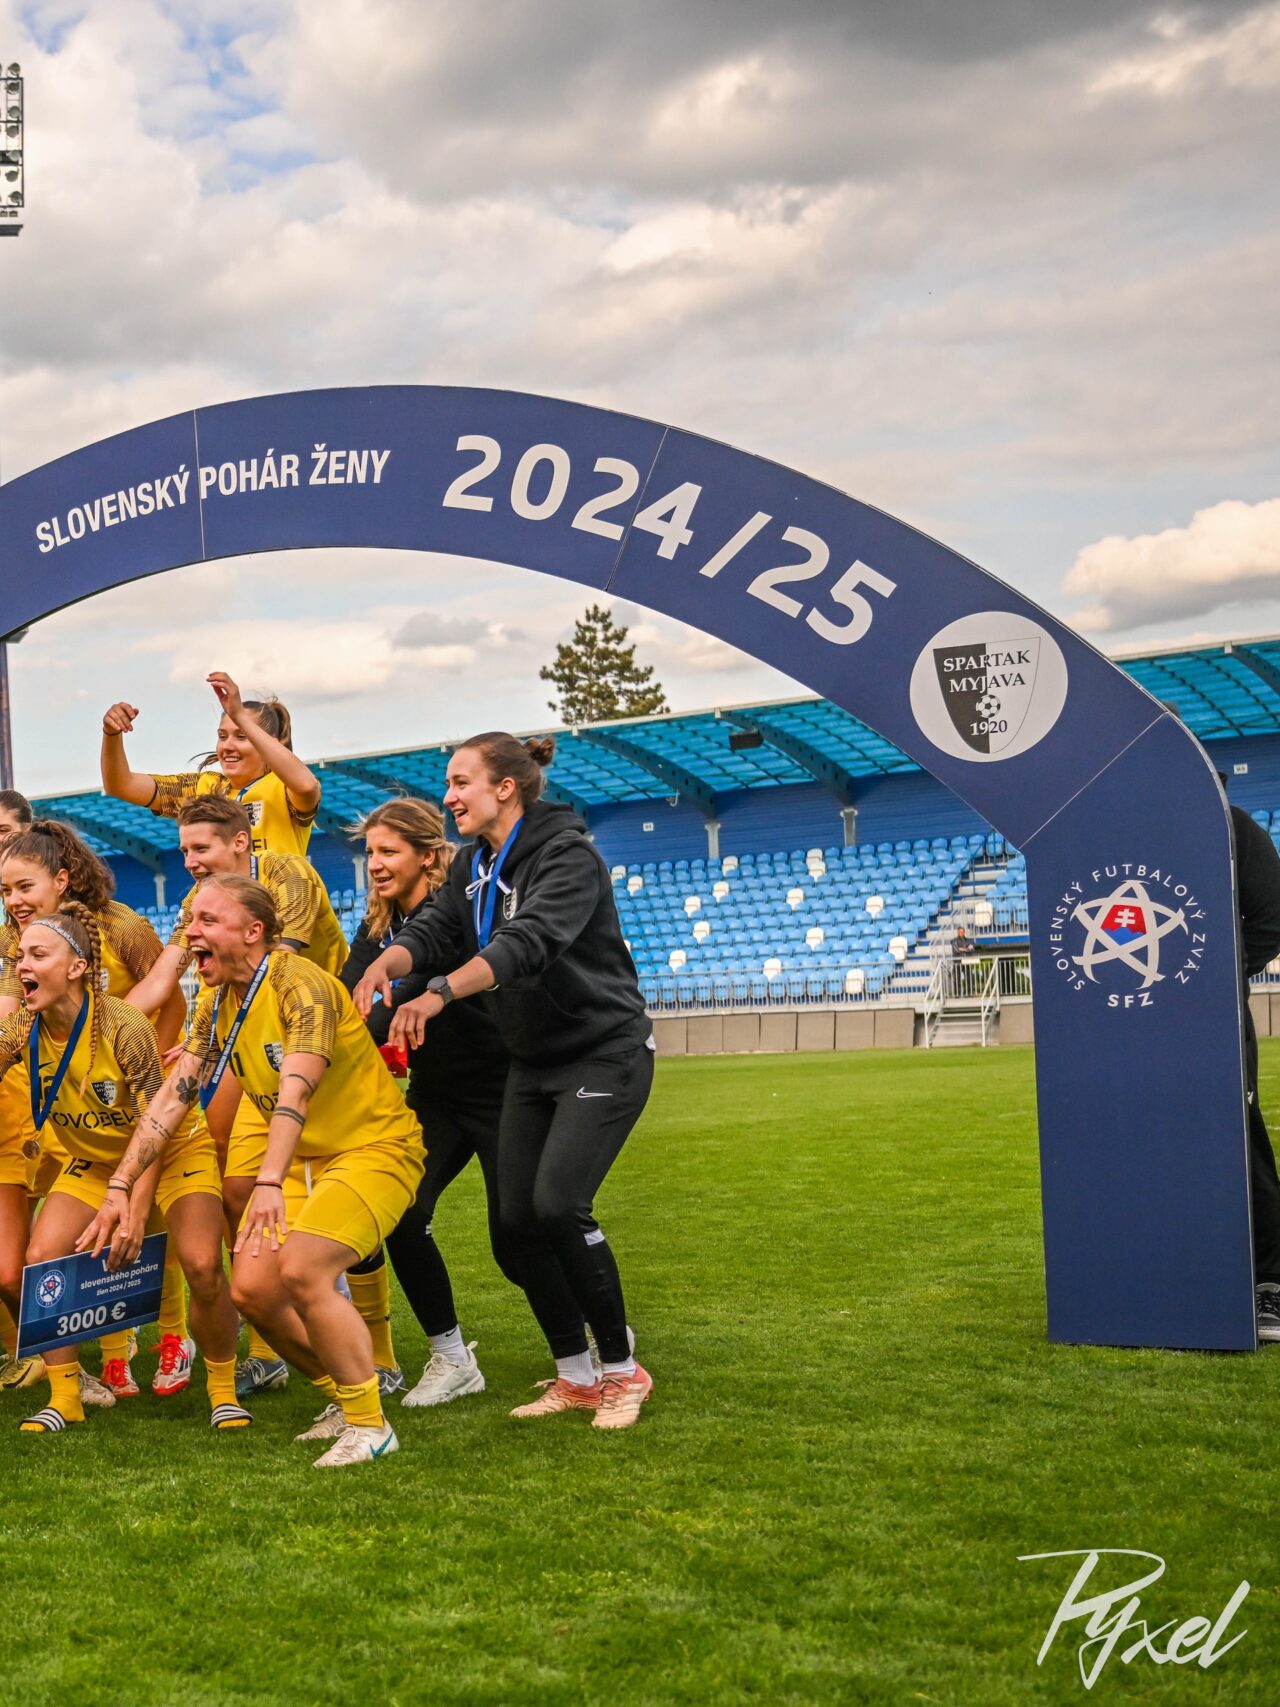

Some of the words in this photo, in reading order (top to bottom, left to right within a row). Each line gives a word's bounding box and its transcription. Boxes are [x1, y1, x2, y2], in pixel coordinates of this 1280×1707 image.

[35, 464, 191, 554] SLOVENSKÝ
[199, 448, 299, 500] POHÁR
[309, 443, 391, 486] ŽENY
[442, 434, 898, 646] 2024/25
[943, 650, 1031, 672] SPARTAK
[949, 672, 1026, 693] MYJAVA
[970, 720, 1008, 735] 1920
[1050, 881, 1085, 990] SLOVENSKÝ
[1092, 864, 1206, 919] FUTBALOVÝ
[1174, 933, 1206, 984] ZVÄZ
[1107, 992, 1154, 1008] SFZ
[49, 1109, 135, 1129] OVOBEL
[63, 1156, 93, 1178] 12
[80, 1271, 130, 1290] slovenského
[130, 1263, 159, 1279] pohára
[57, 1305, 107, 1336] 3000
[111, 1301, 127, 1321] €
